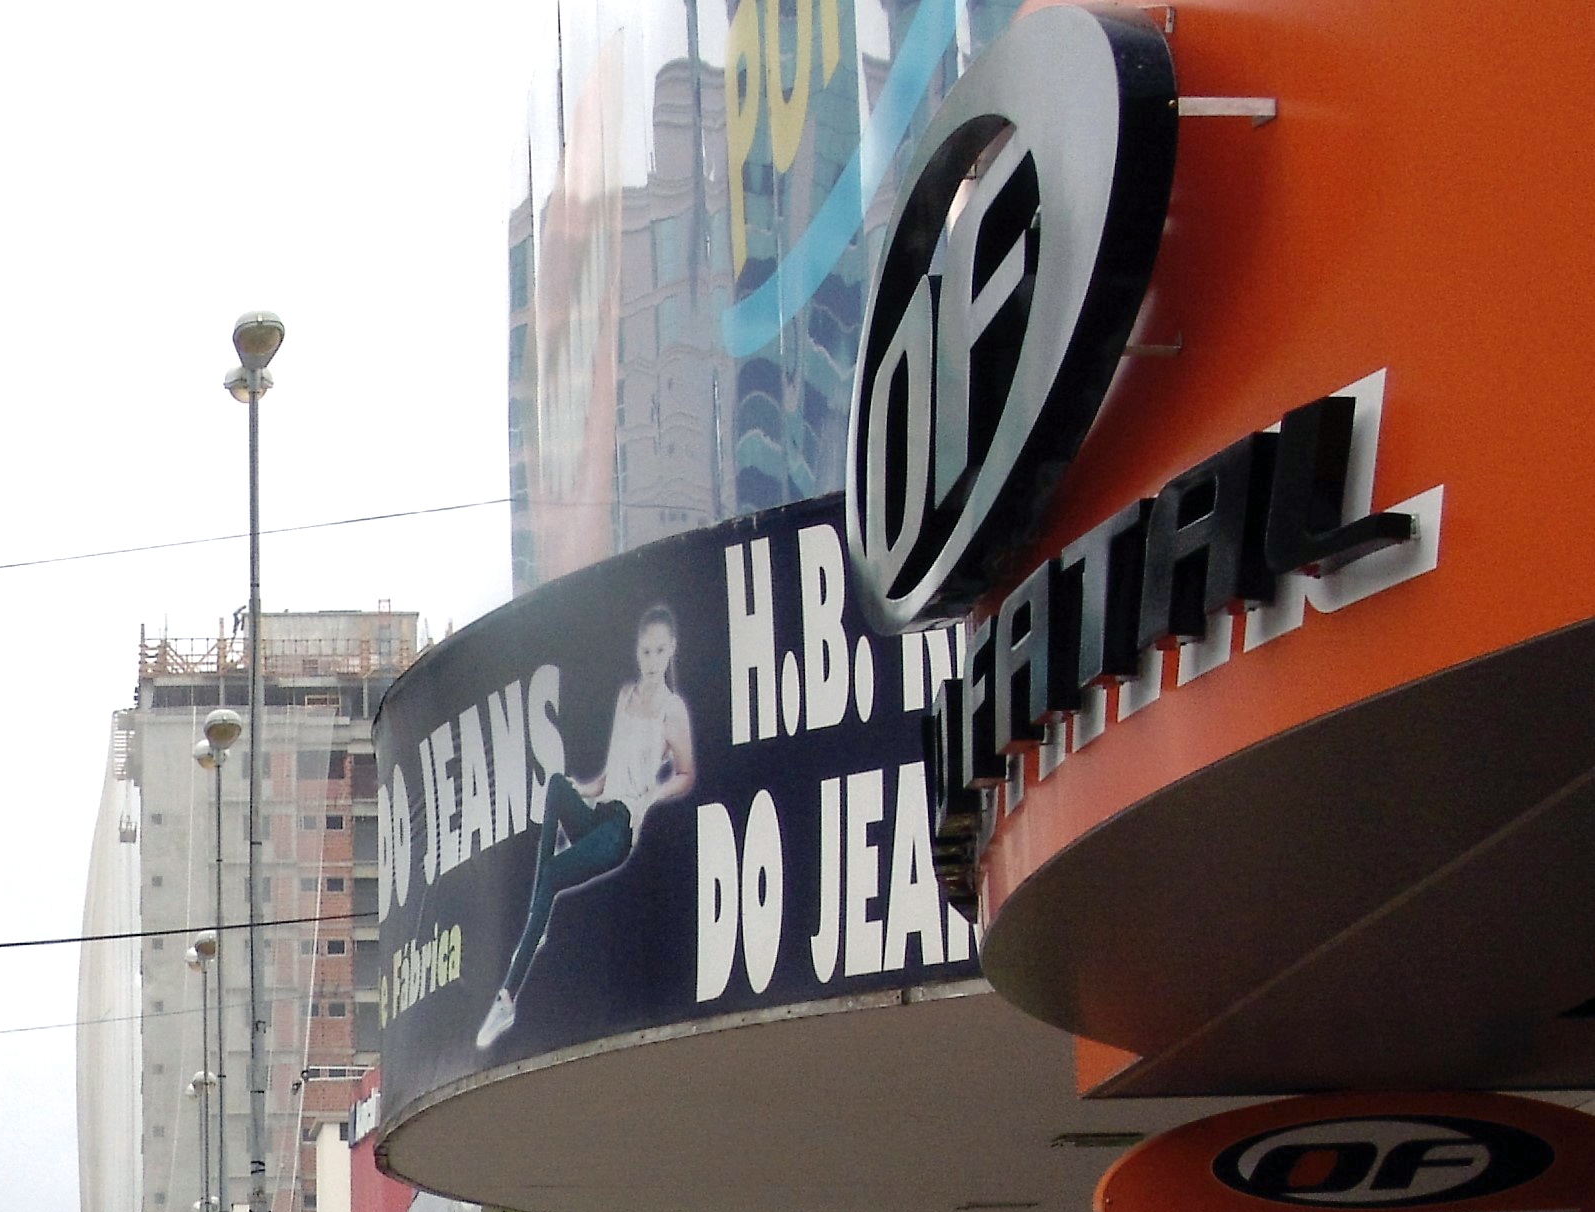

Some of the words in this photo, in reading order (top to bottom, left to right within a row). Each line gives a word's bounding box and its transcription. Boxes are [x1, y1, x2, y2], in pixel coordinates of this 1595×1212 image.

[961, 372, 1434, 792] FATAL
[418, 663, 567, 887] JEANS
[696, 788, 784, 1003] DO
[810, 761, 978, 985] JEA
